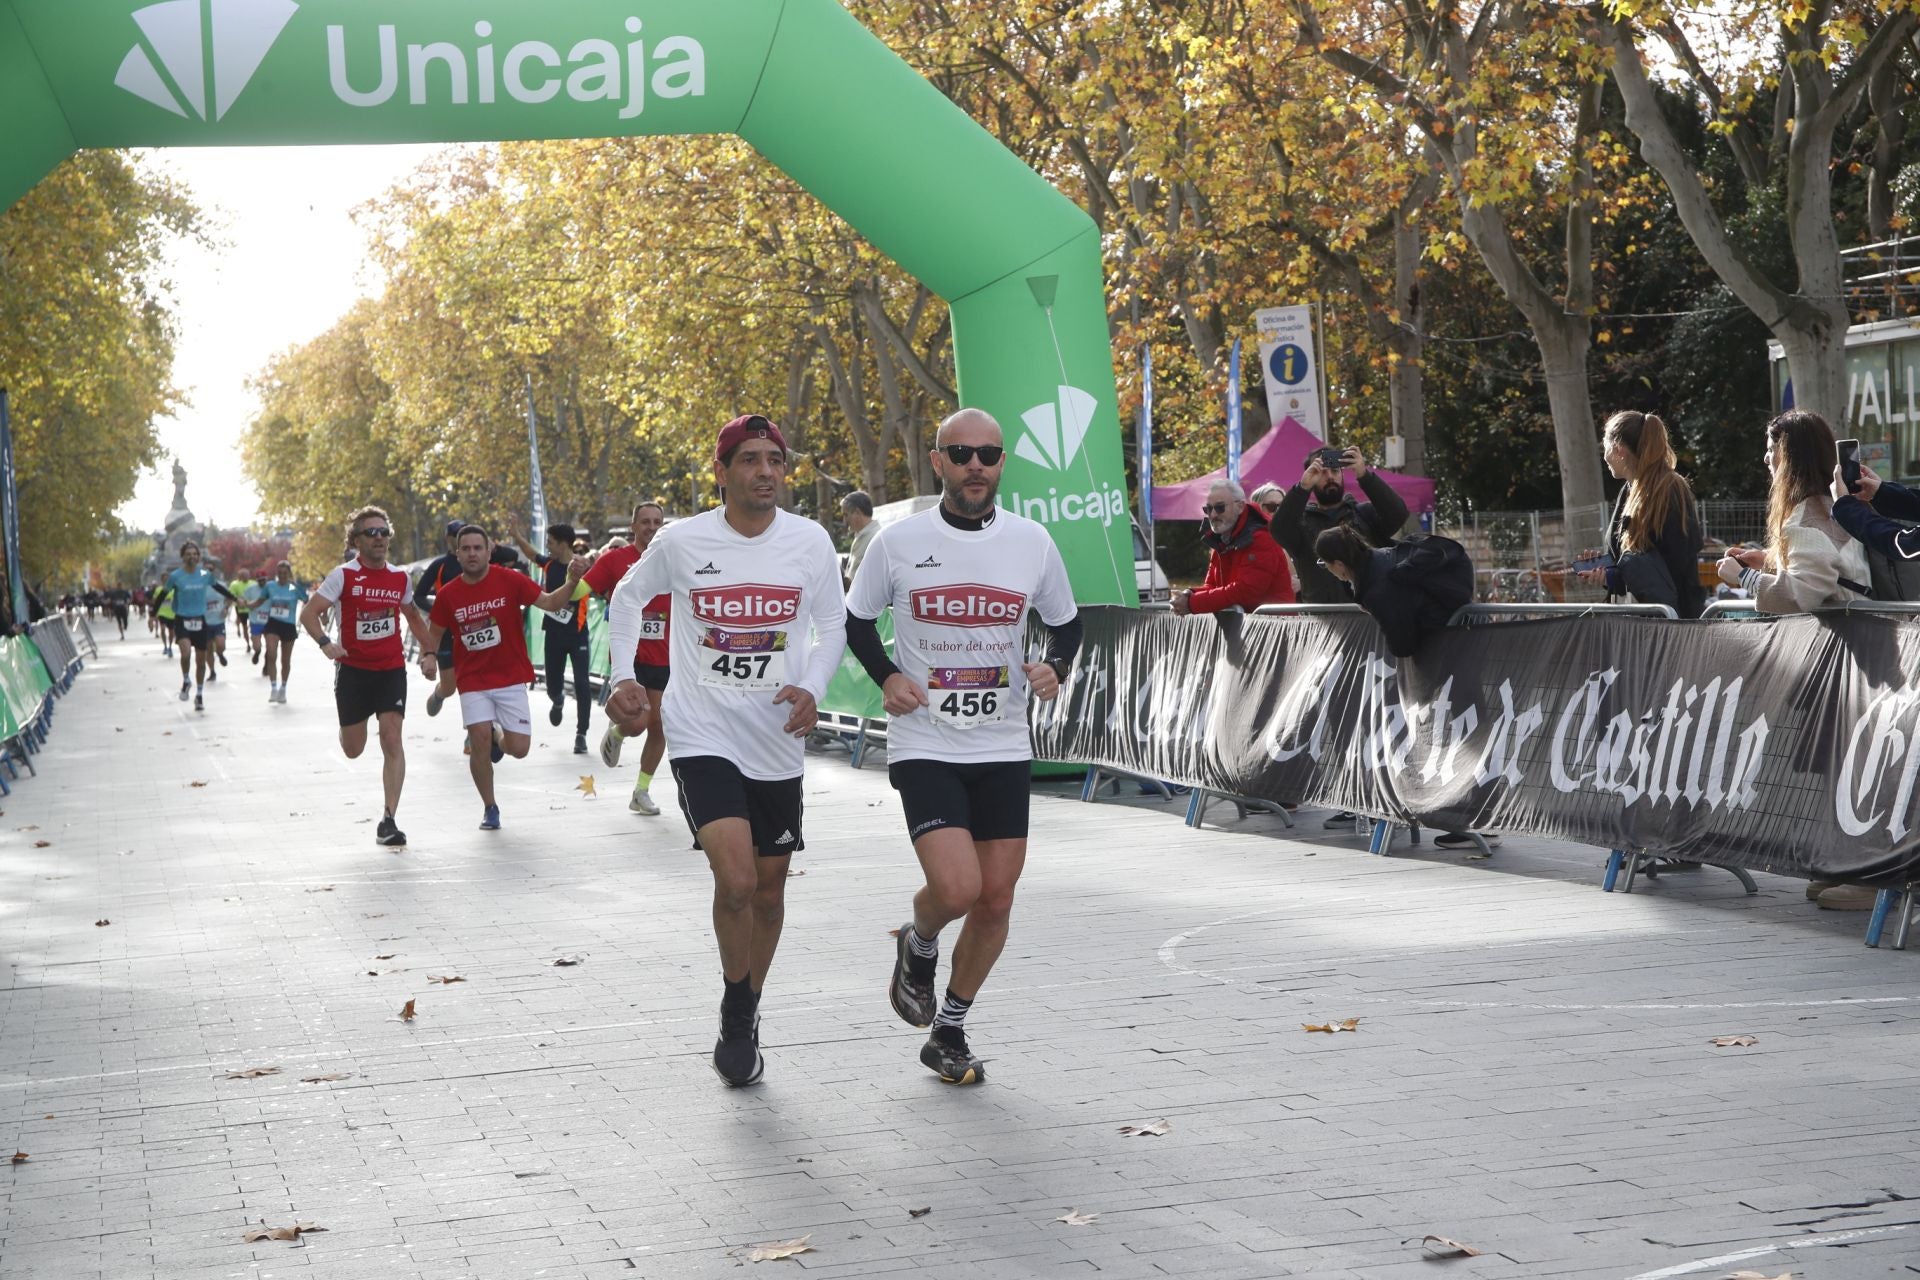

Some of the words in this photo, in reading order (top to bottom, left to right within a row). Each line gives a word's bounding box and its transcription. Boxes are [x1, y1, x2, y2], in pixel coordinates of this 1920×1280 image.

[326, 16, 706, 119] Unicaja
[1263, 316, 1285, 324] Oficina
[467, 597, 506, 615] EIFFAGE
[698, 595, 797, 618] Helios
[918, 595, 1019, 620] Helios
[361, 620, 390, 634] 264
[641, 622, 660, 634] 63
[466, 629, 495, 646] 262
[919, 639, 928, 650] El
[930, 639, 963, 651] sabor
[965, 640, 983, 651] del
[985, 640, 1015, 654] origen
[711, 654, 772, 680] 457
[940, 691, 998, 717] 456
[1472, 677, 1544, 789] de
[1550, 665, 1770, 815] Castilla
[911, 818, 947, 837] LURBEL
